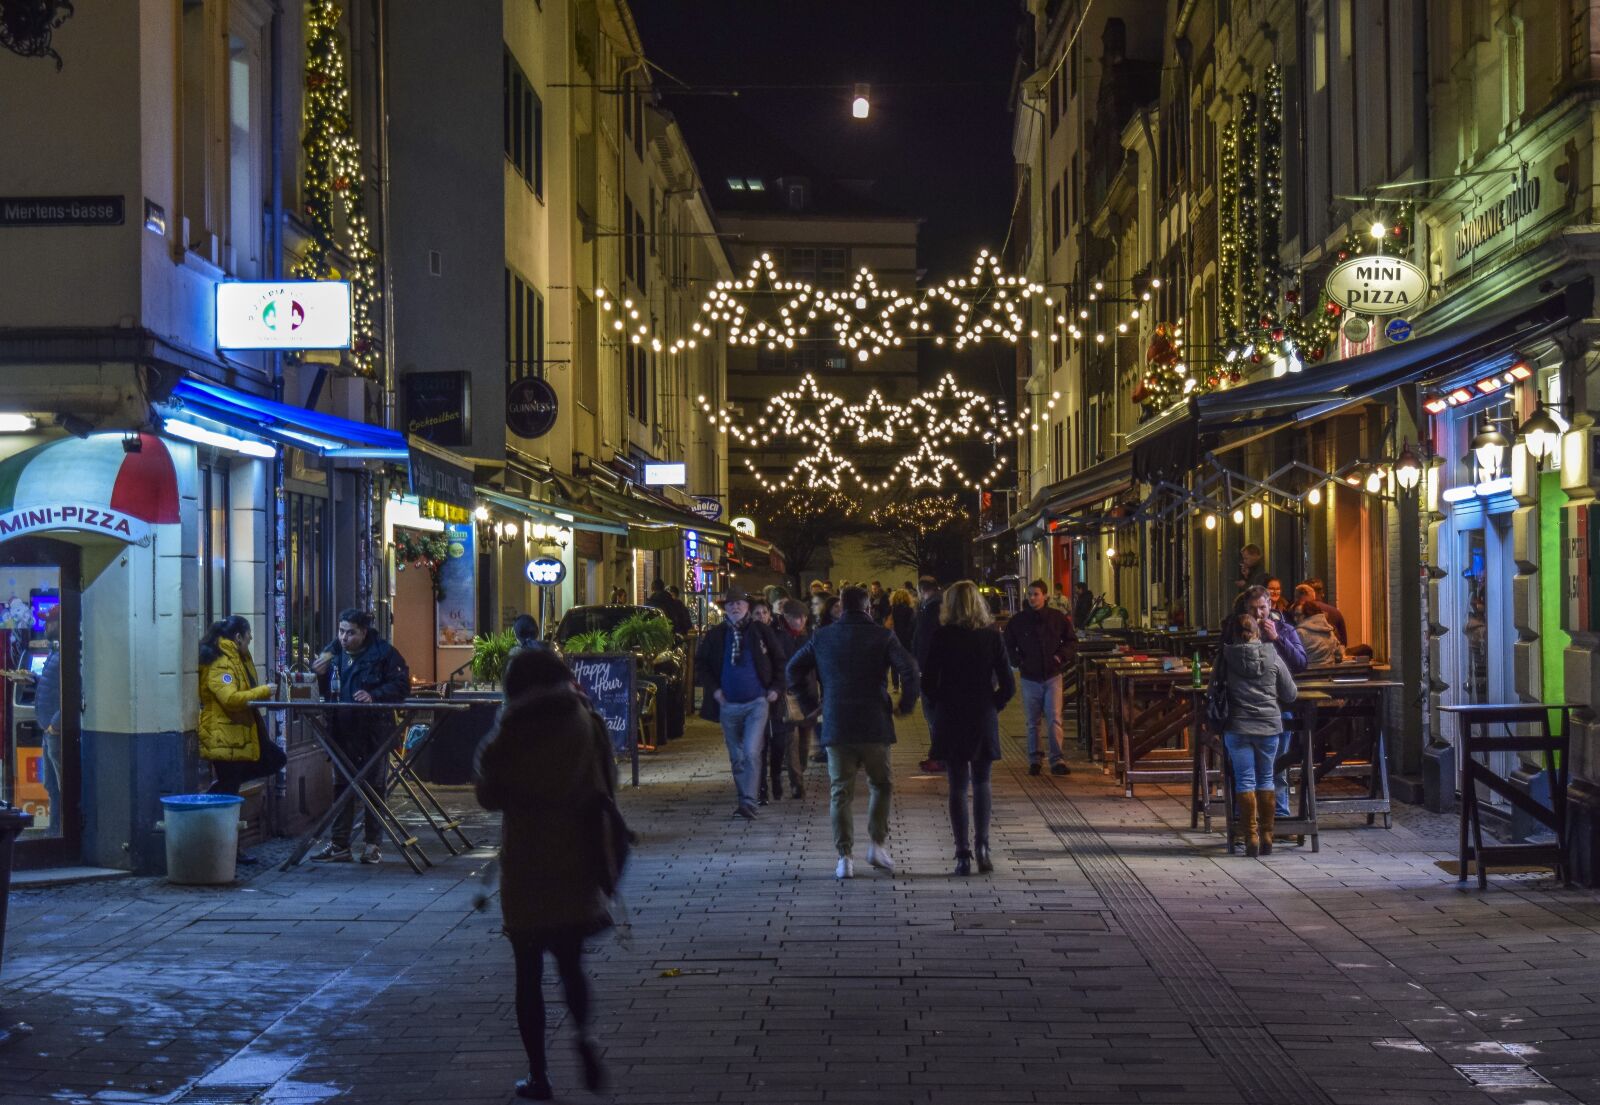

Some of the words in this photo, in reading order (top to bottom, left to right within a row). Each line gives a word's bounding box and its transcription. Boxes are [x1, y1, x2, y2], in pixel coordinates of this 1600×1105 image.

[5, 201, 114, 220] Mertens-Gasse
[509, 400, 551, 413] GUINNESS
[408, 411, 460, 432] Cocktailbar
[0, 506, 131, 536] MINI-PIZZA
[571, 660, 610, 684] Happy
[591, 677, 623, 700] Hour
